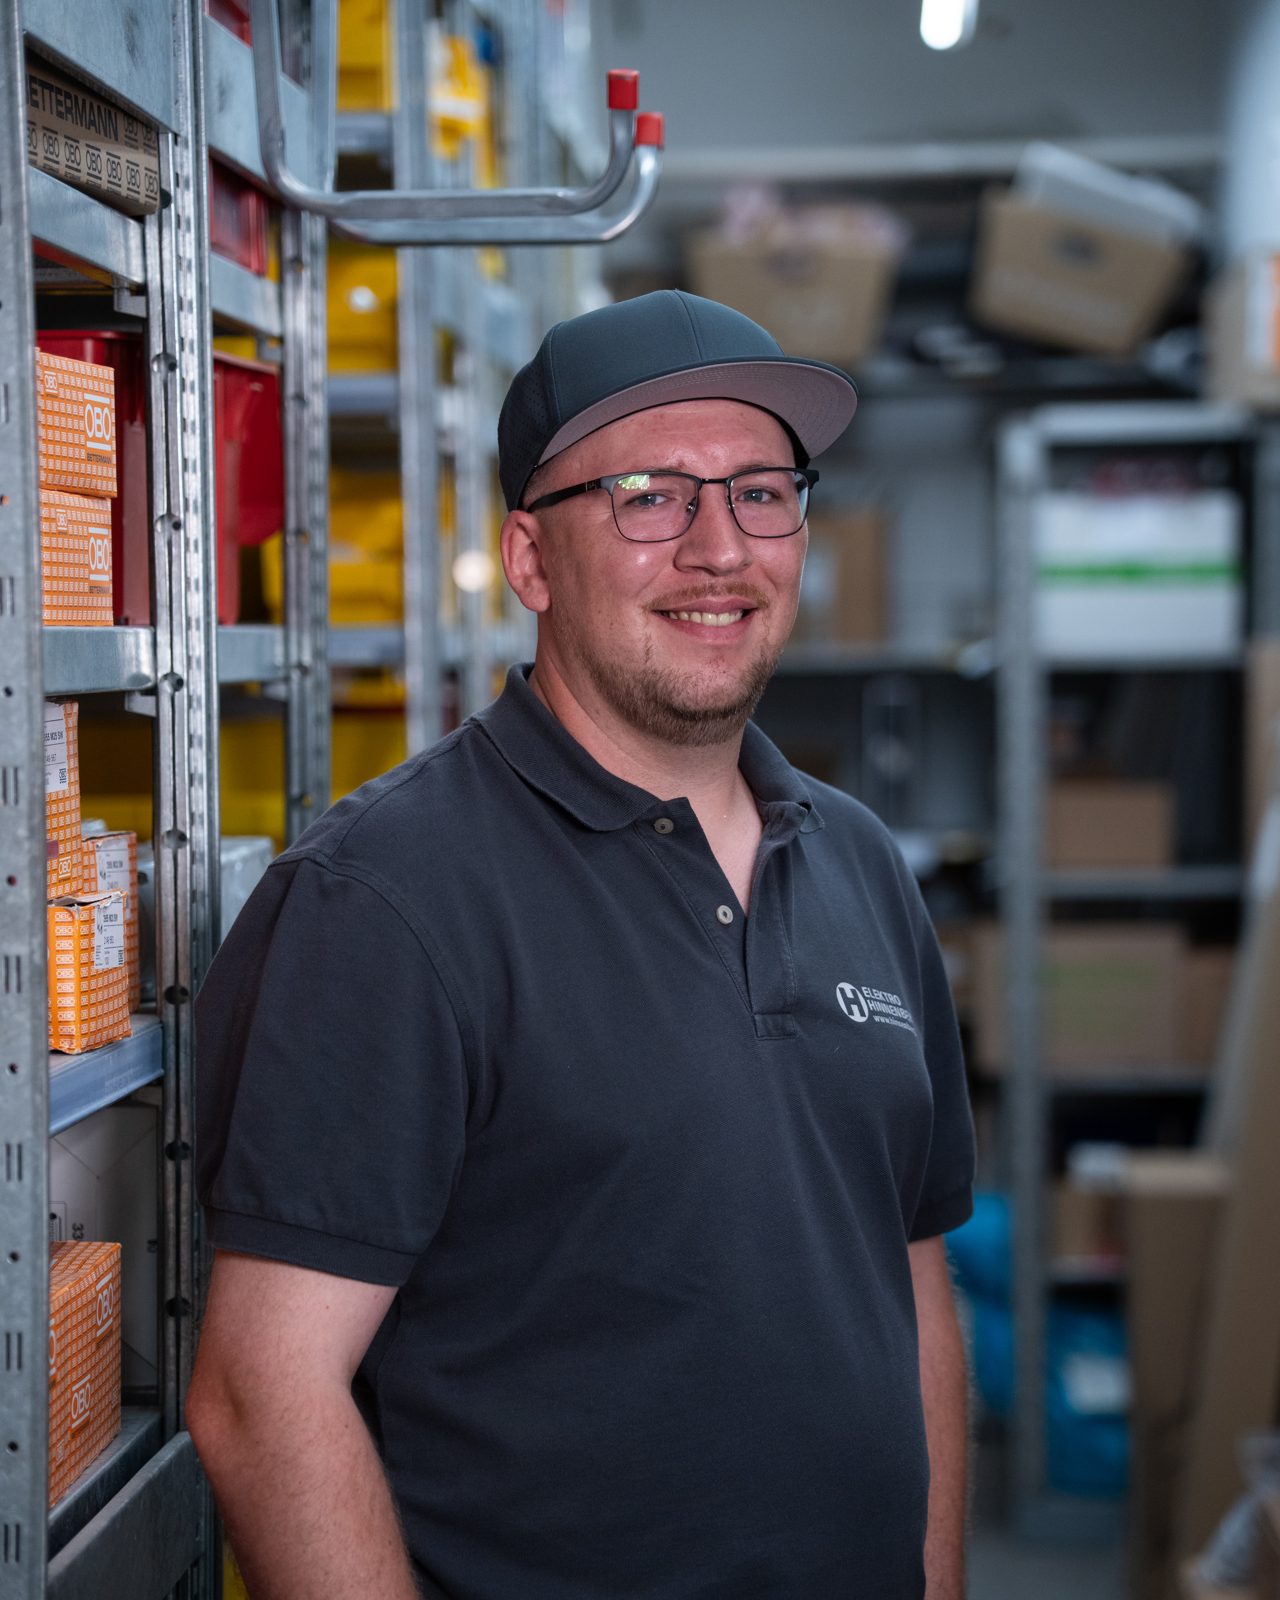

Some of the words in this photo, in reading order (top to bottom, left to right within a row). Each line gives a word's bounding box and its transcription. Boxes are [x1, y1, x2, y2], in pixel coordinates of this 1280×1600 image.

[26, 75, 119, 142] ETTERMANN
[43, 133, 60, 158] OBO
[64, 142, 81, 166] OBO
[86, 150, 102, 174] OBO
[106, 158, 122, 182] OBO
[126, 165, 141, 189] OBO
[144, 173, 158, 195] OBO
[44, 374, 57, 390] OBO
[85, 403, 111, 441] OBO
[89, 537, 110, 571] OBO
[837, 984, 868, 1020] H
[861, 986, 902, 1006] ELEKTRO
[96, 1282, 114, 1327] OBO
[71, 1382, 91, 1420] OBO
